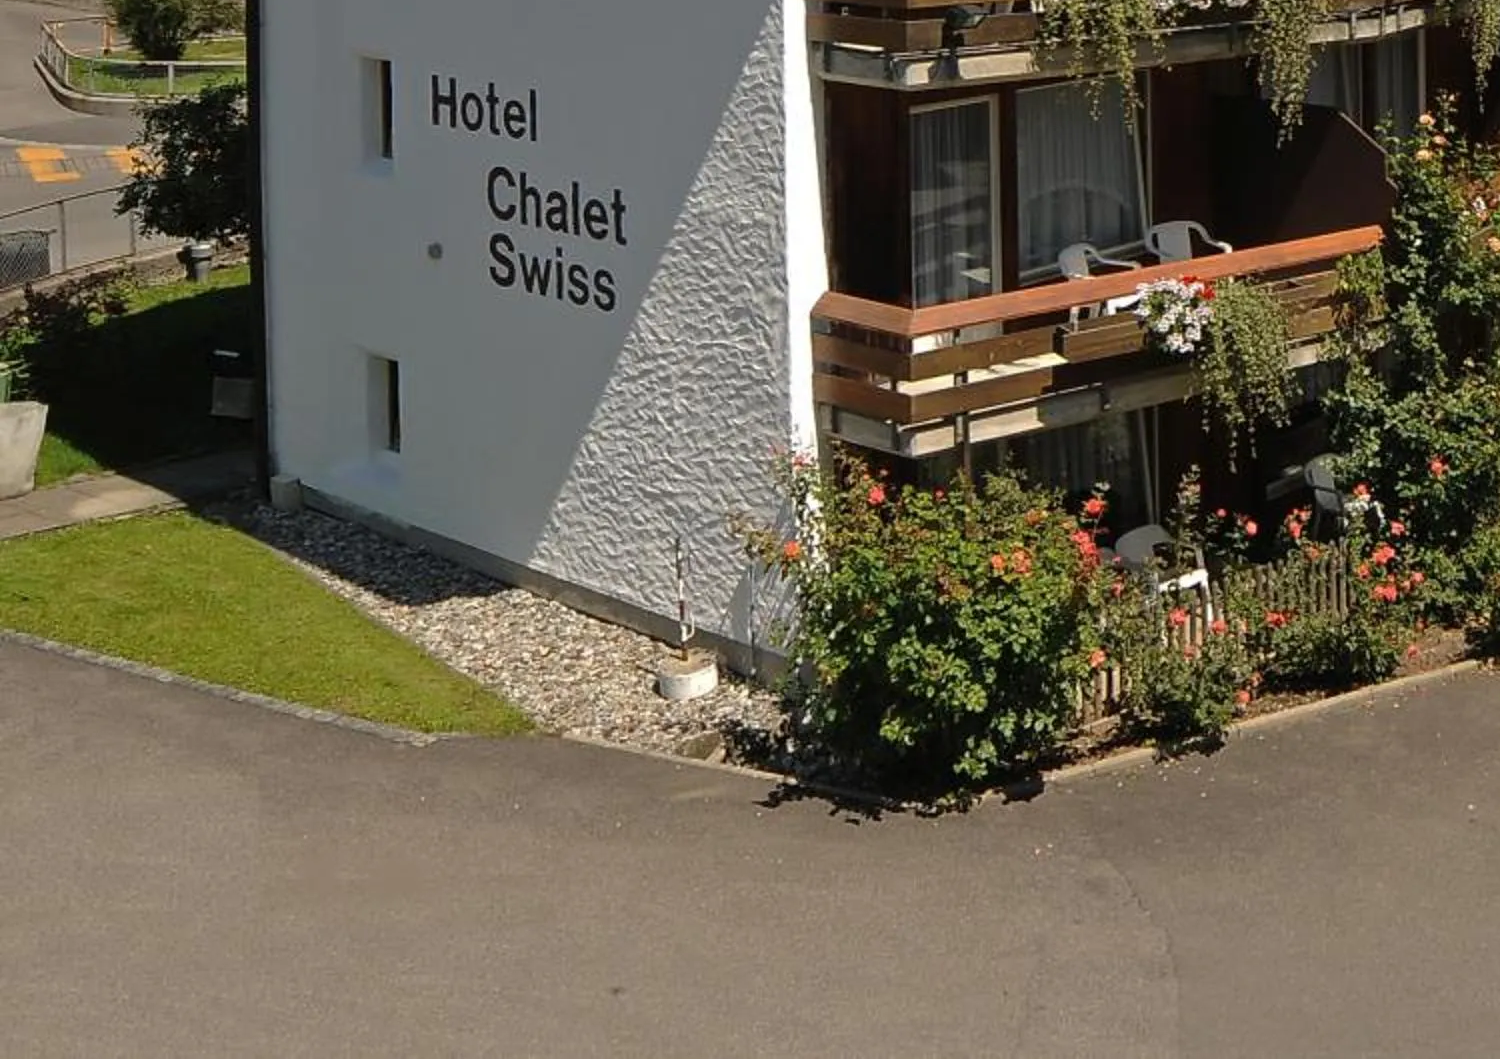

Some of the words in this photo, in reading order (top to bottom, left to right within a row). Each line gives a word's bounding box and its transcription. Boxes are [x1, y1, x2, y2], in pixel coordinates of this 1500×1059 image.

[431, 74, 537, 142] Hotel
[487, 166, 628, 246] Chalet
[489, 232, 616, 312] Swiss
